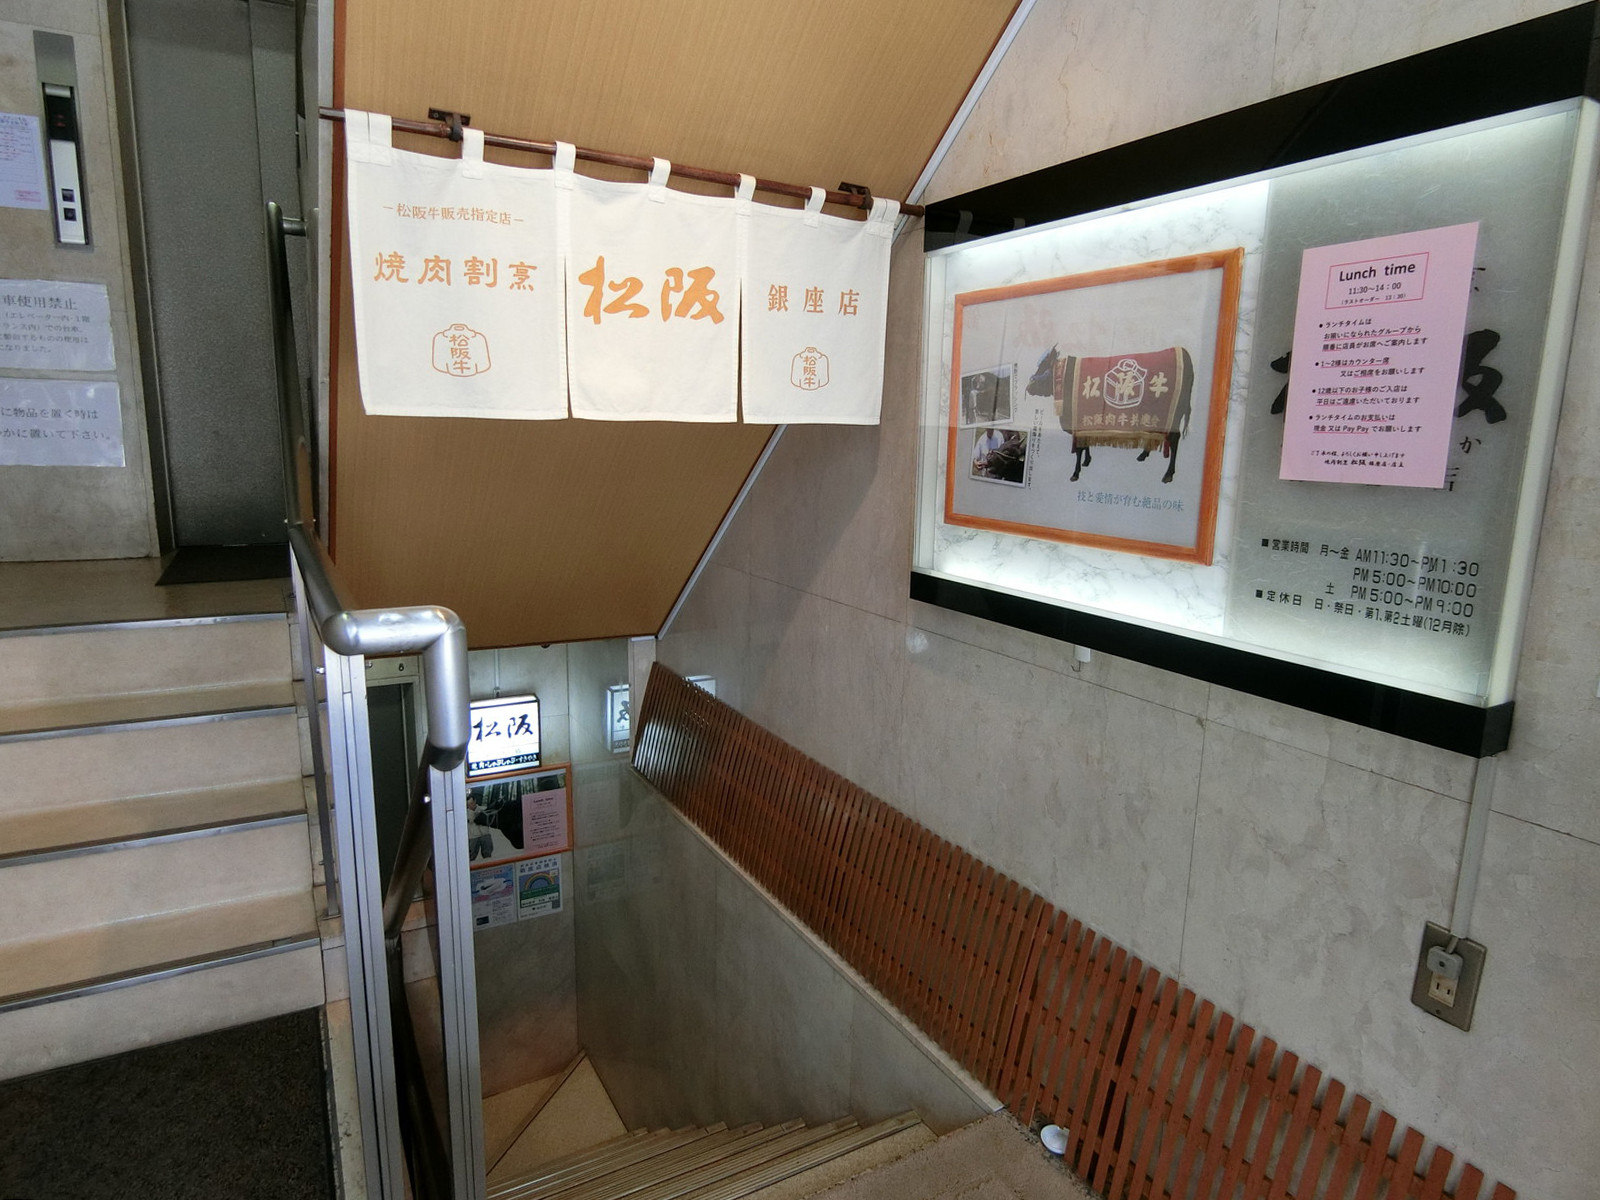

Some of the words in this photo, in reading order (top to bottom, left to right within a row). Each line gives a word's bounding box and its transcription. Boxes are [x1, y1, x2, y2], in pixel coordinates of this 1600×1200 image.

[373, 251, 538, 292] 焼肉割烹
[1339, 266, 1377, 282] Lunch
[1384, 263, 1416, 276] time
[578, 254, 725, 325] 松阪
[767, 284, 861, 316] 銀座店
[1325, 318, 1372, 329] ランチタイムは
[449, 334, 471, 375] 松阪牛
[803, 355, 818, 388] 松阪牛
[1272, 539, 1310, 555] 営業時間
[1266, 590, 1303, 606] 定休日
[472, 713, 534, 742] 松阪
